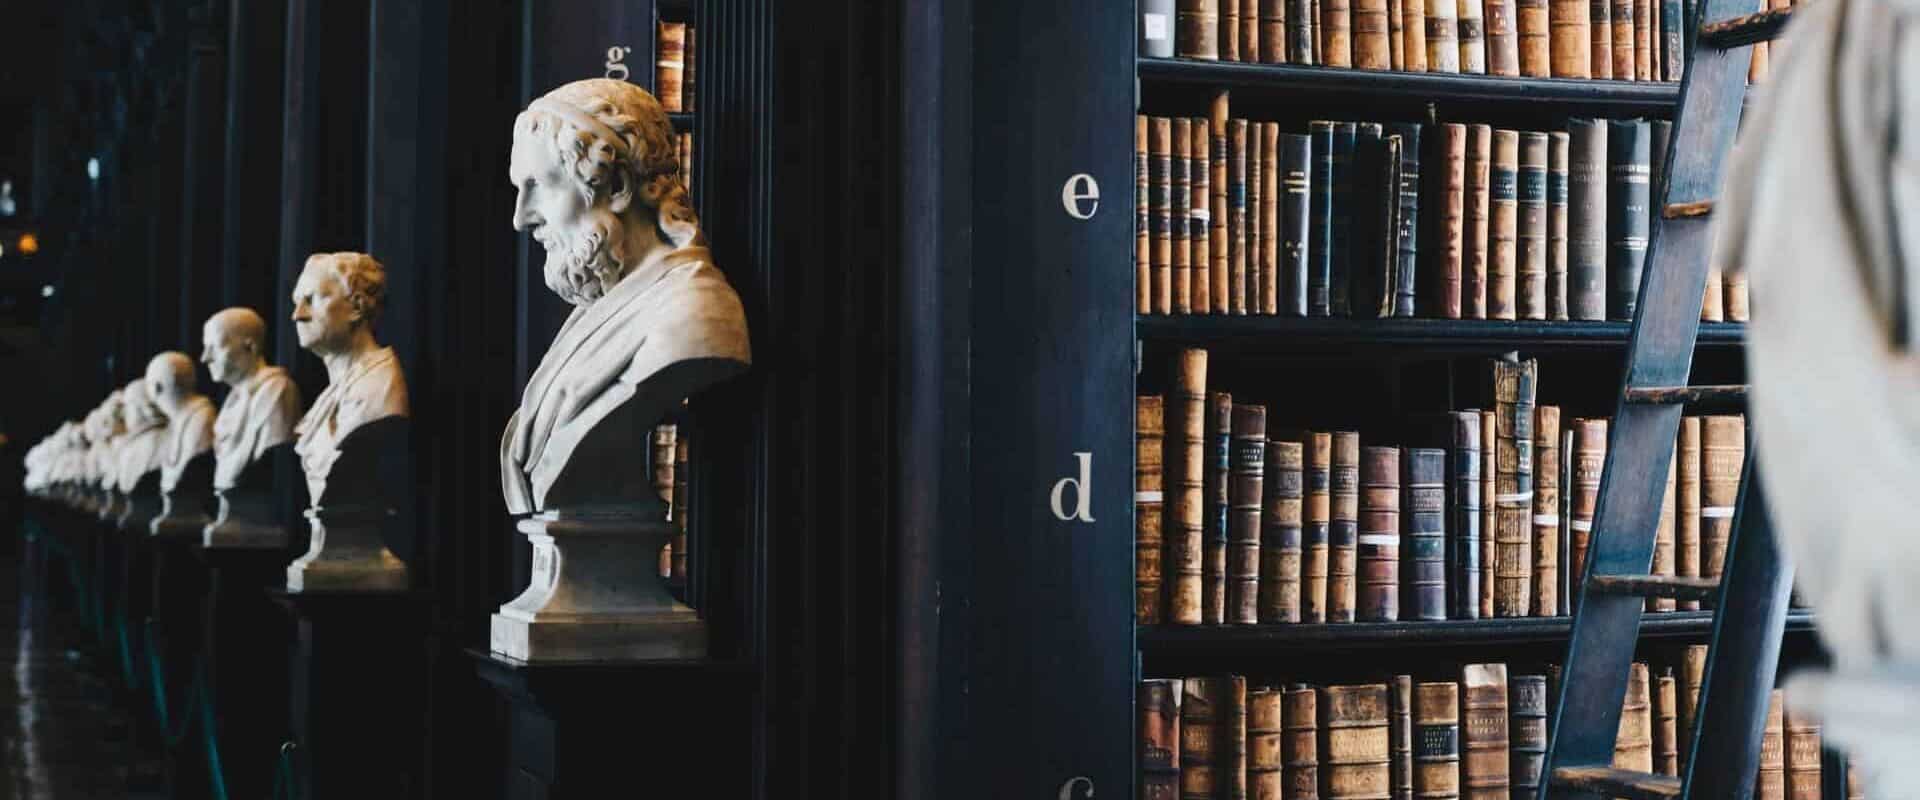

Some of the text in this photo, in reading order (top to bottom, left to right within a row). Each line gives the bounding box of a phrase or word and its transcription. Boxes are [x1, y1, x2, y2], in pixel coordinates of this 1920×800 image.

[605, 46, 631, 80] g
[1062, 173, 1100, 219] e
[1050, 452, 1096, 522] d
